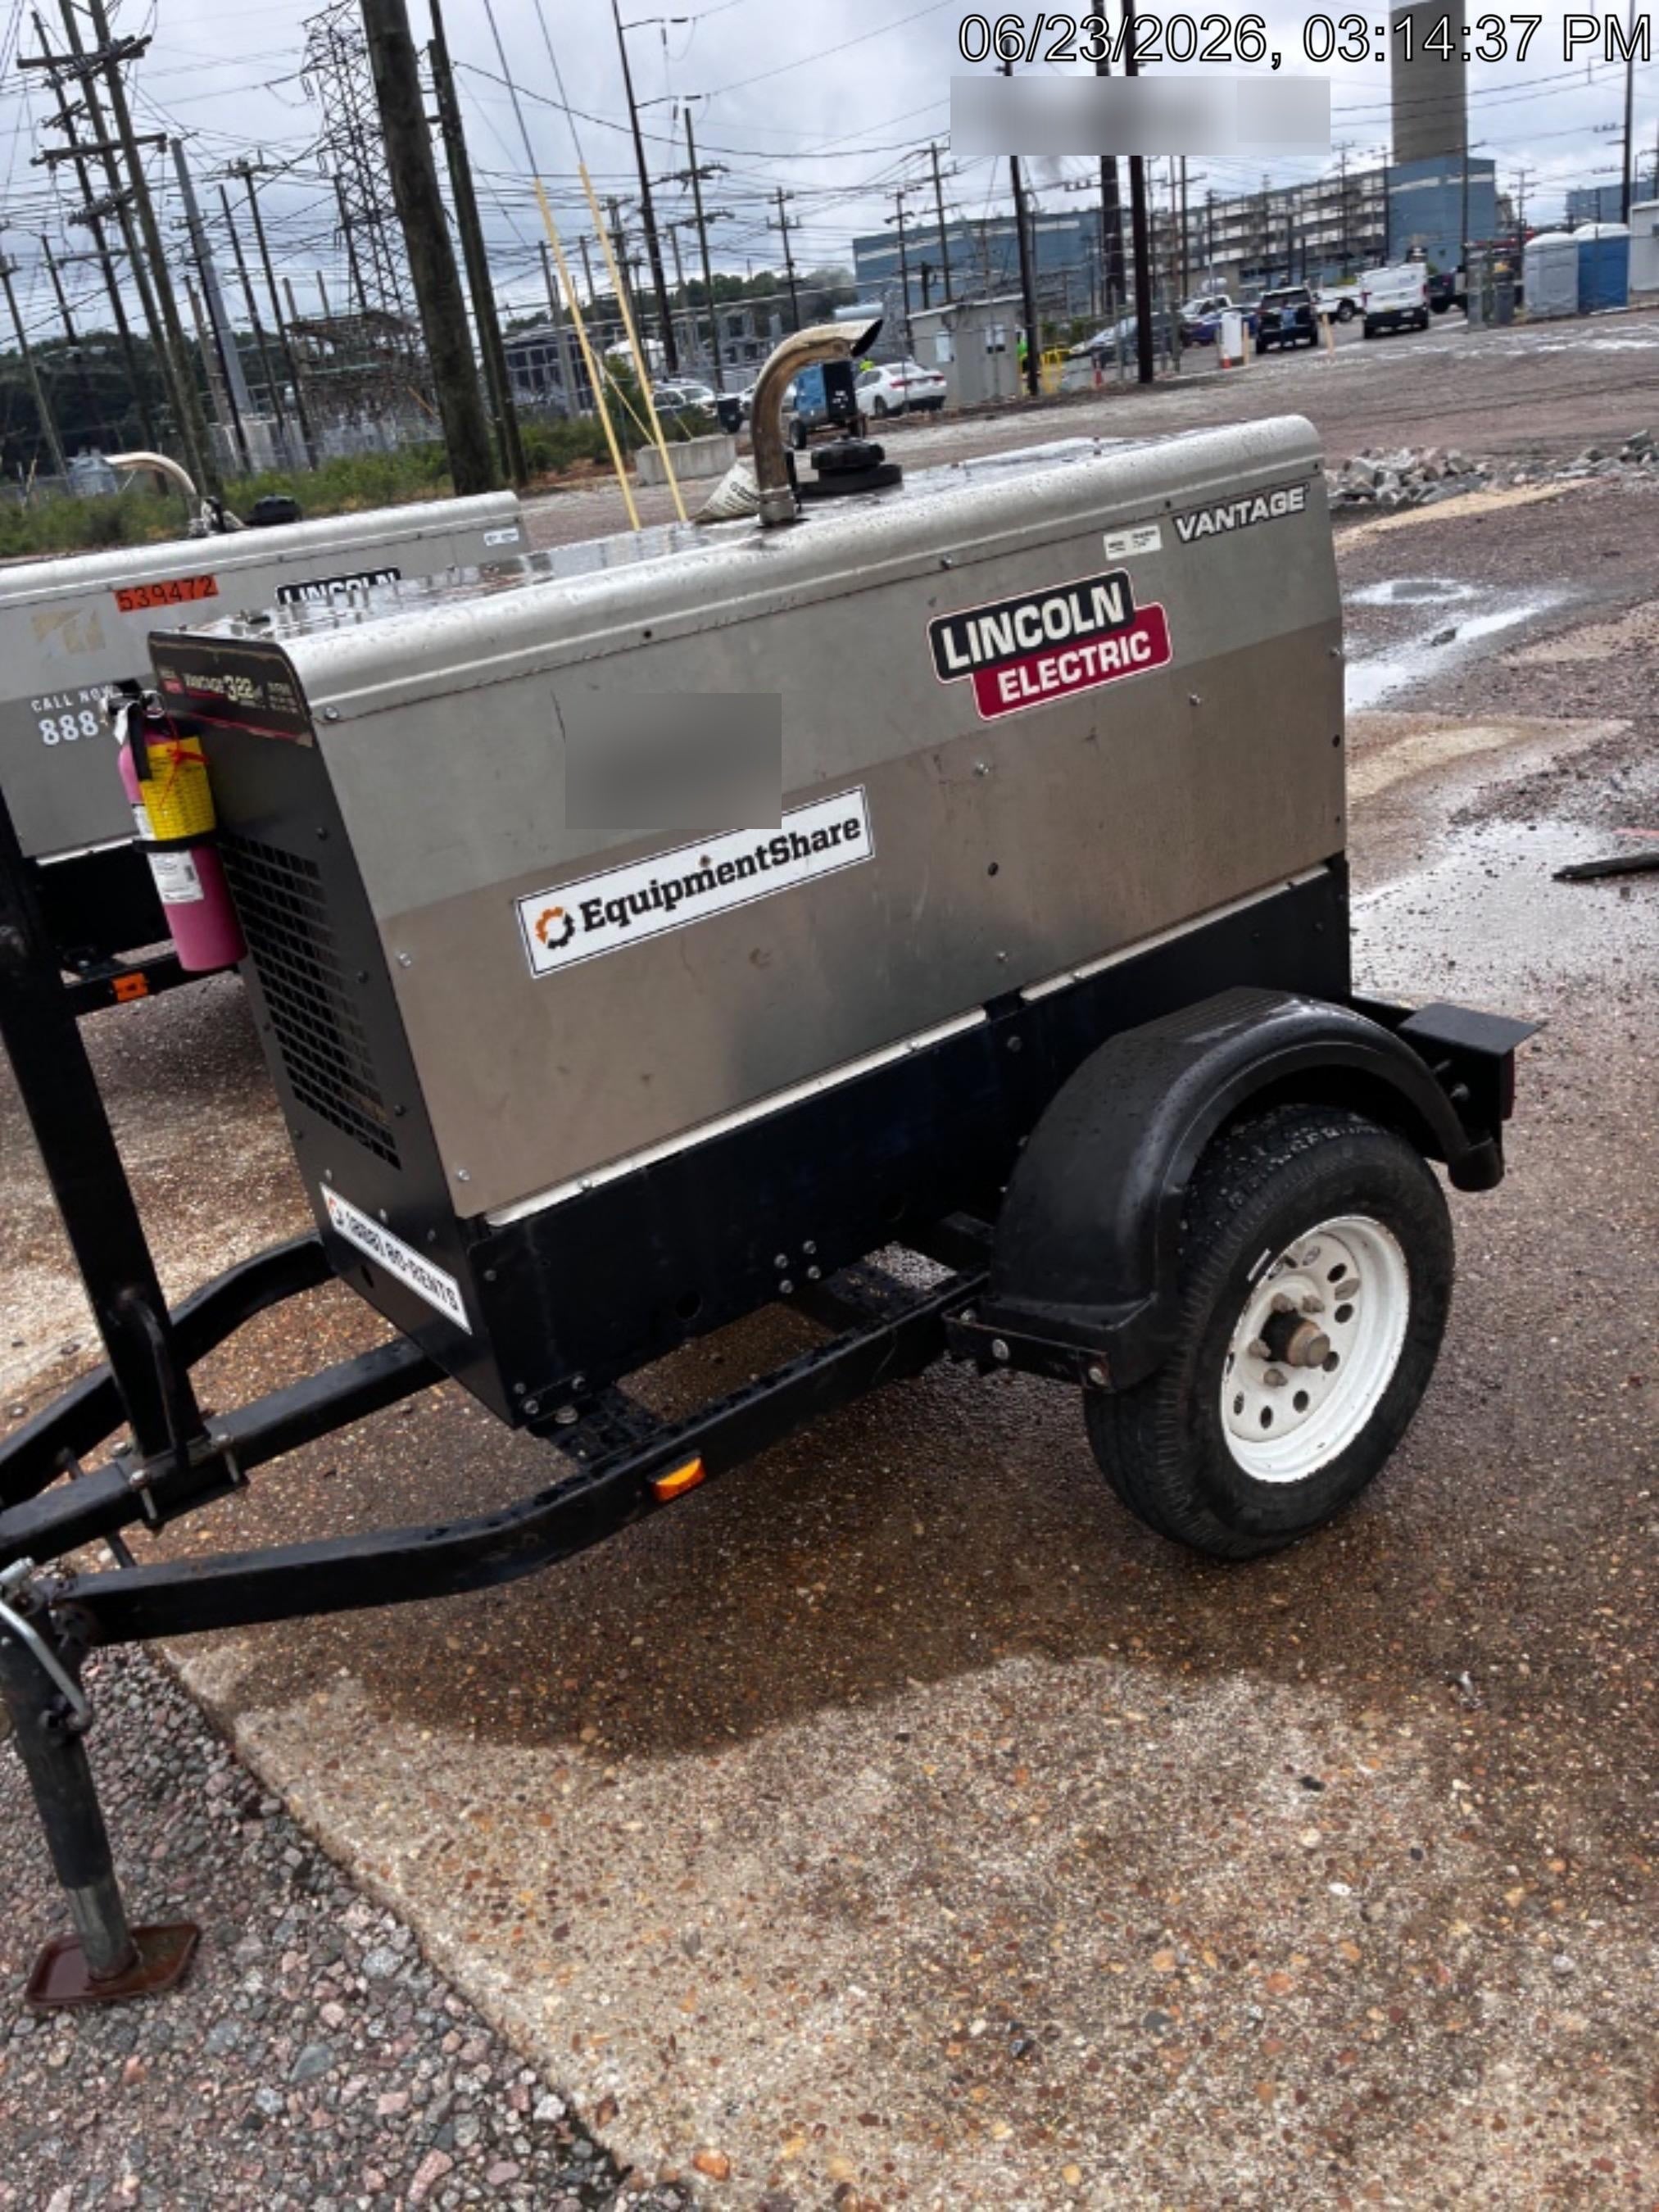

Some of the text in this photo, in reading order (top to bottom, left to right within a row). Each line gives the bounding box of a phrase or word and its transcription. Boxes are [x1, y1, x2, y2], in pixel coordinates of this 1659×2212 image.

[1175, 486, 1307, 544] VANTAGE
[116, 574, 219, 612] 539472
[941, 582, 1126, 670] LINCOLN
[31, 685, 115, 713] CALL NOW
[998, 632, 1151, 704] ELECTRIC
[578, 817, 861, 932] EquipmentShare
